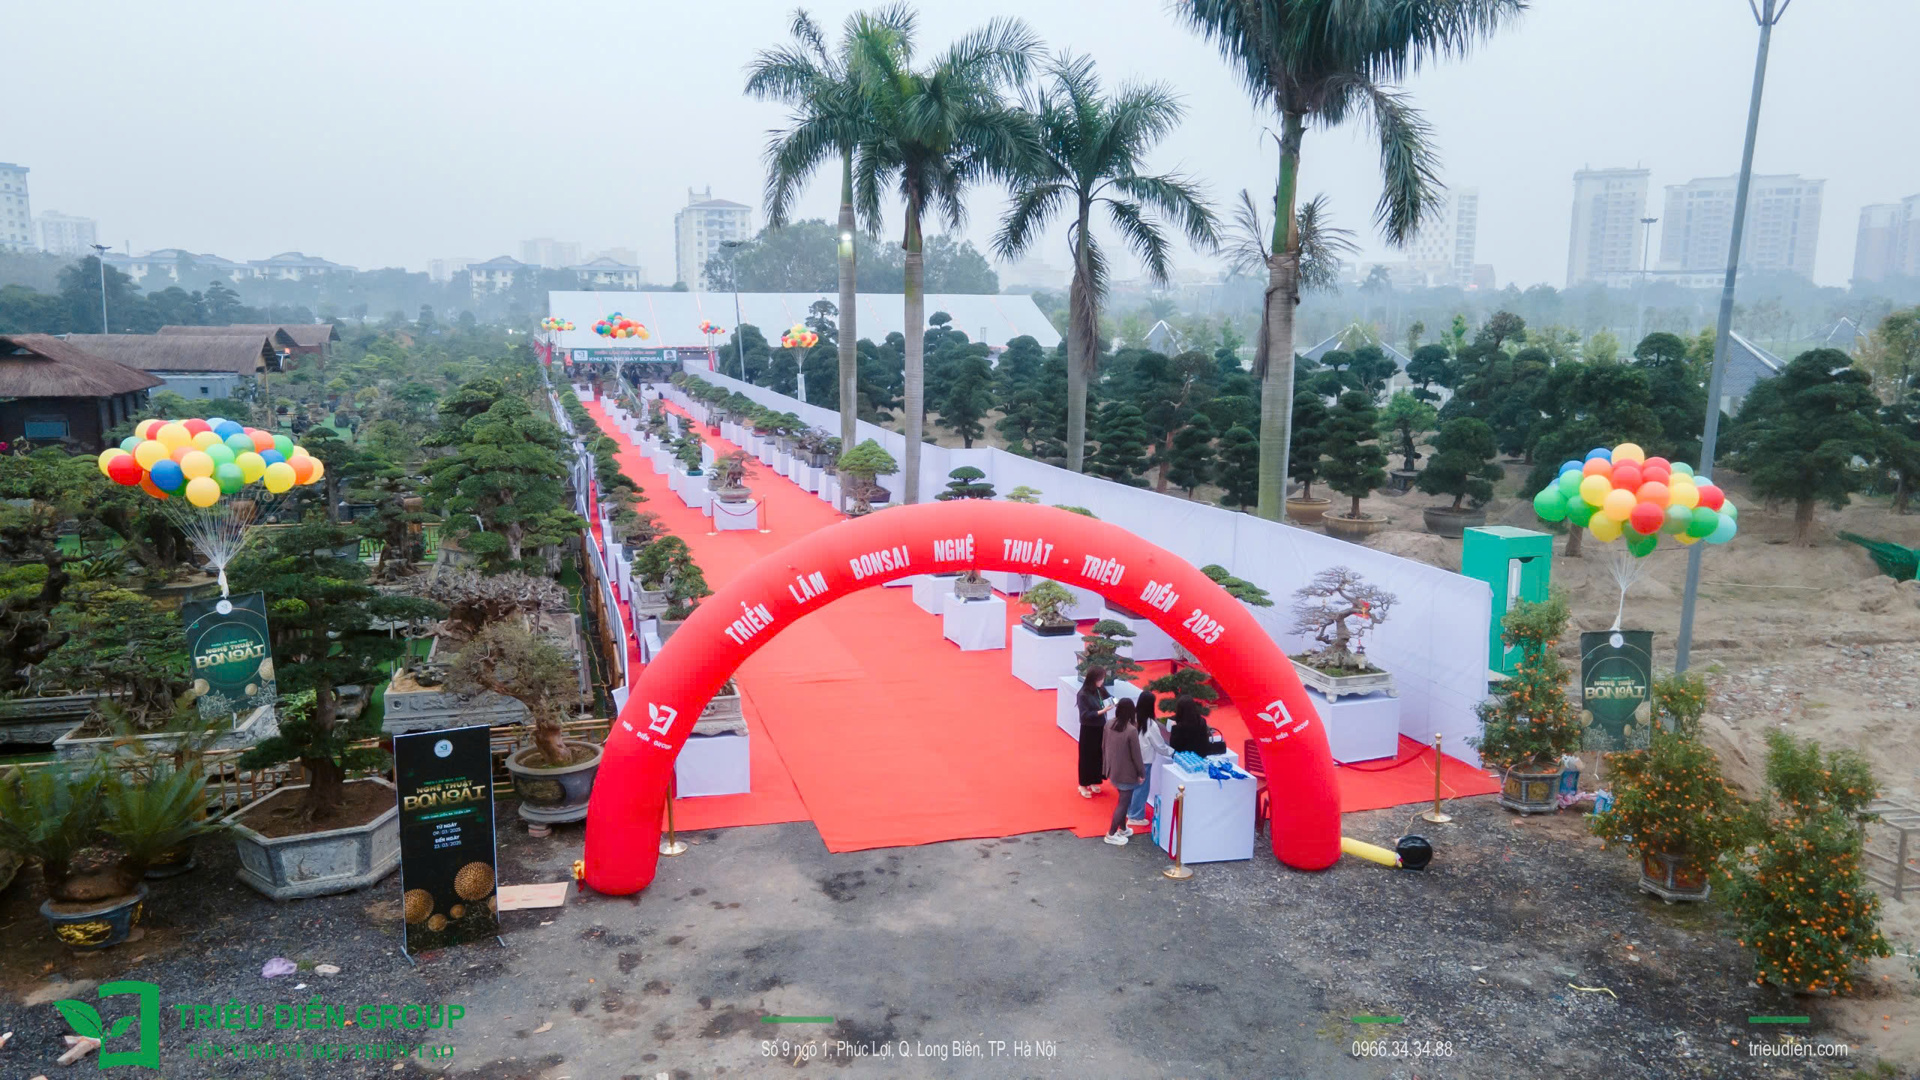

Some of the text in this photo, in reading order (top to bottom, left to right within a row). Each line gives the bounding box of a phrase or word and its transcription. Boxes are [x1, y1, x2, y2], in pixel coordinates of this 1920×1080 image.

[724, 601, 775, 646] TRIỂN
[788, 572, 829, 605] LÃM
[849, 545, 911, 580] BONSAI
[933, 534, 974, 562] NGHỆ
[1003, 538, 1053, 567] THUẬT
[1080, 554, 1126, 586] TRIỆU
[1182, 608, 1225, 645] 2025
